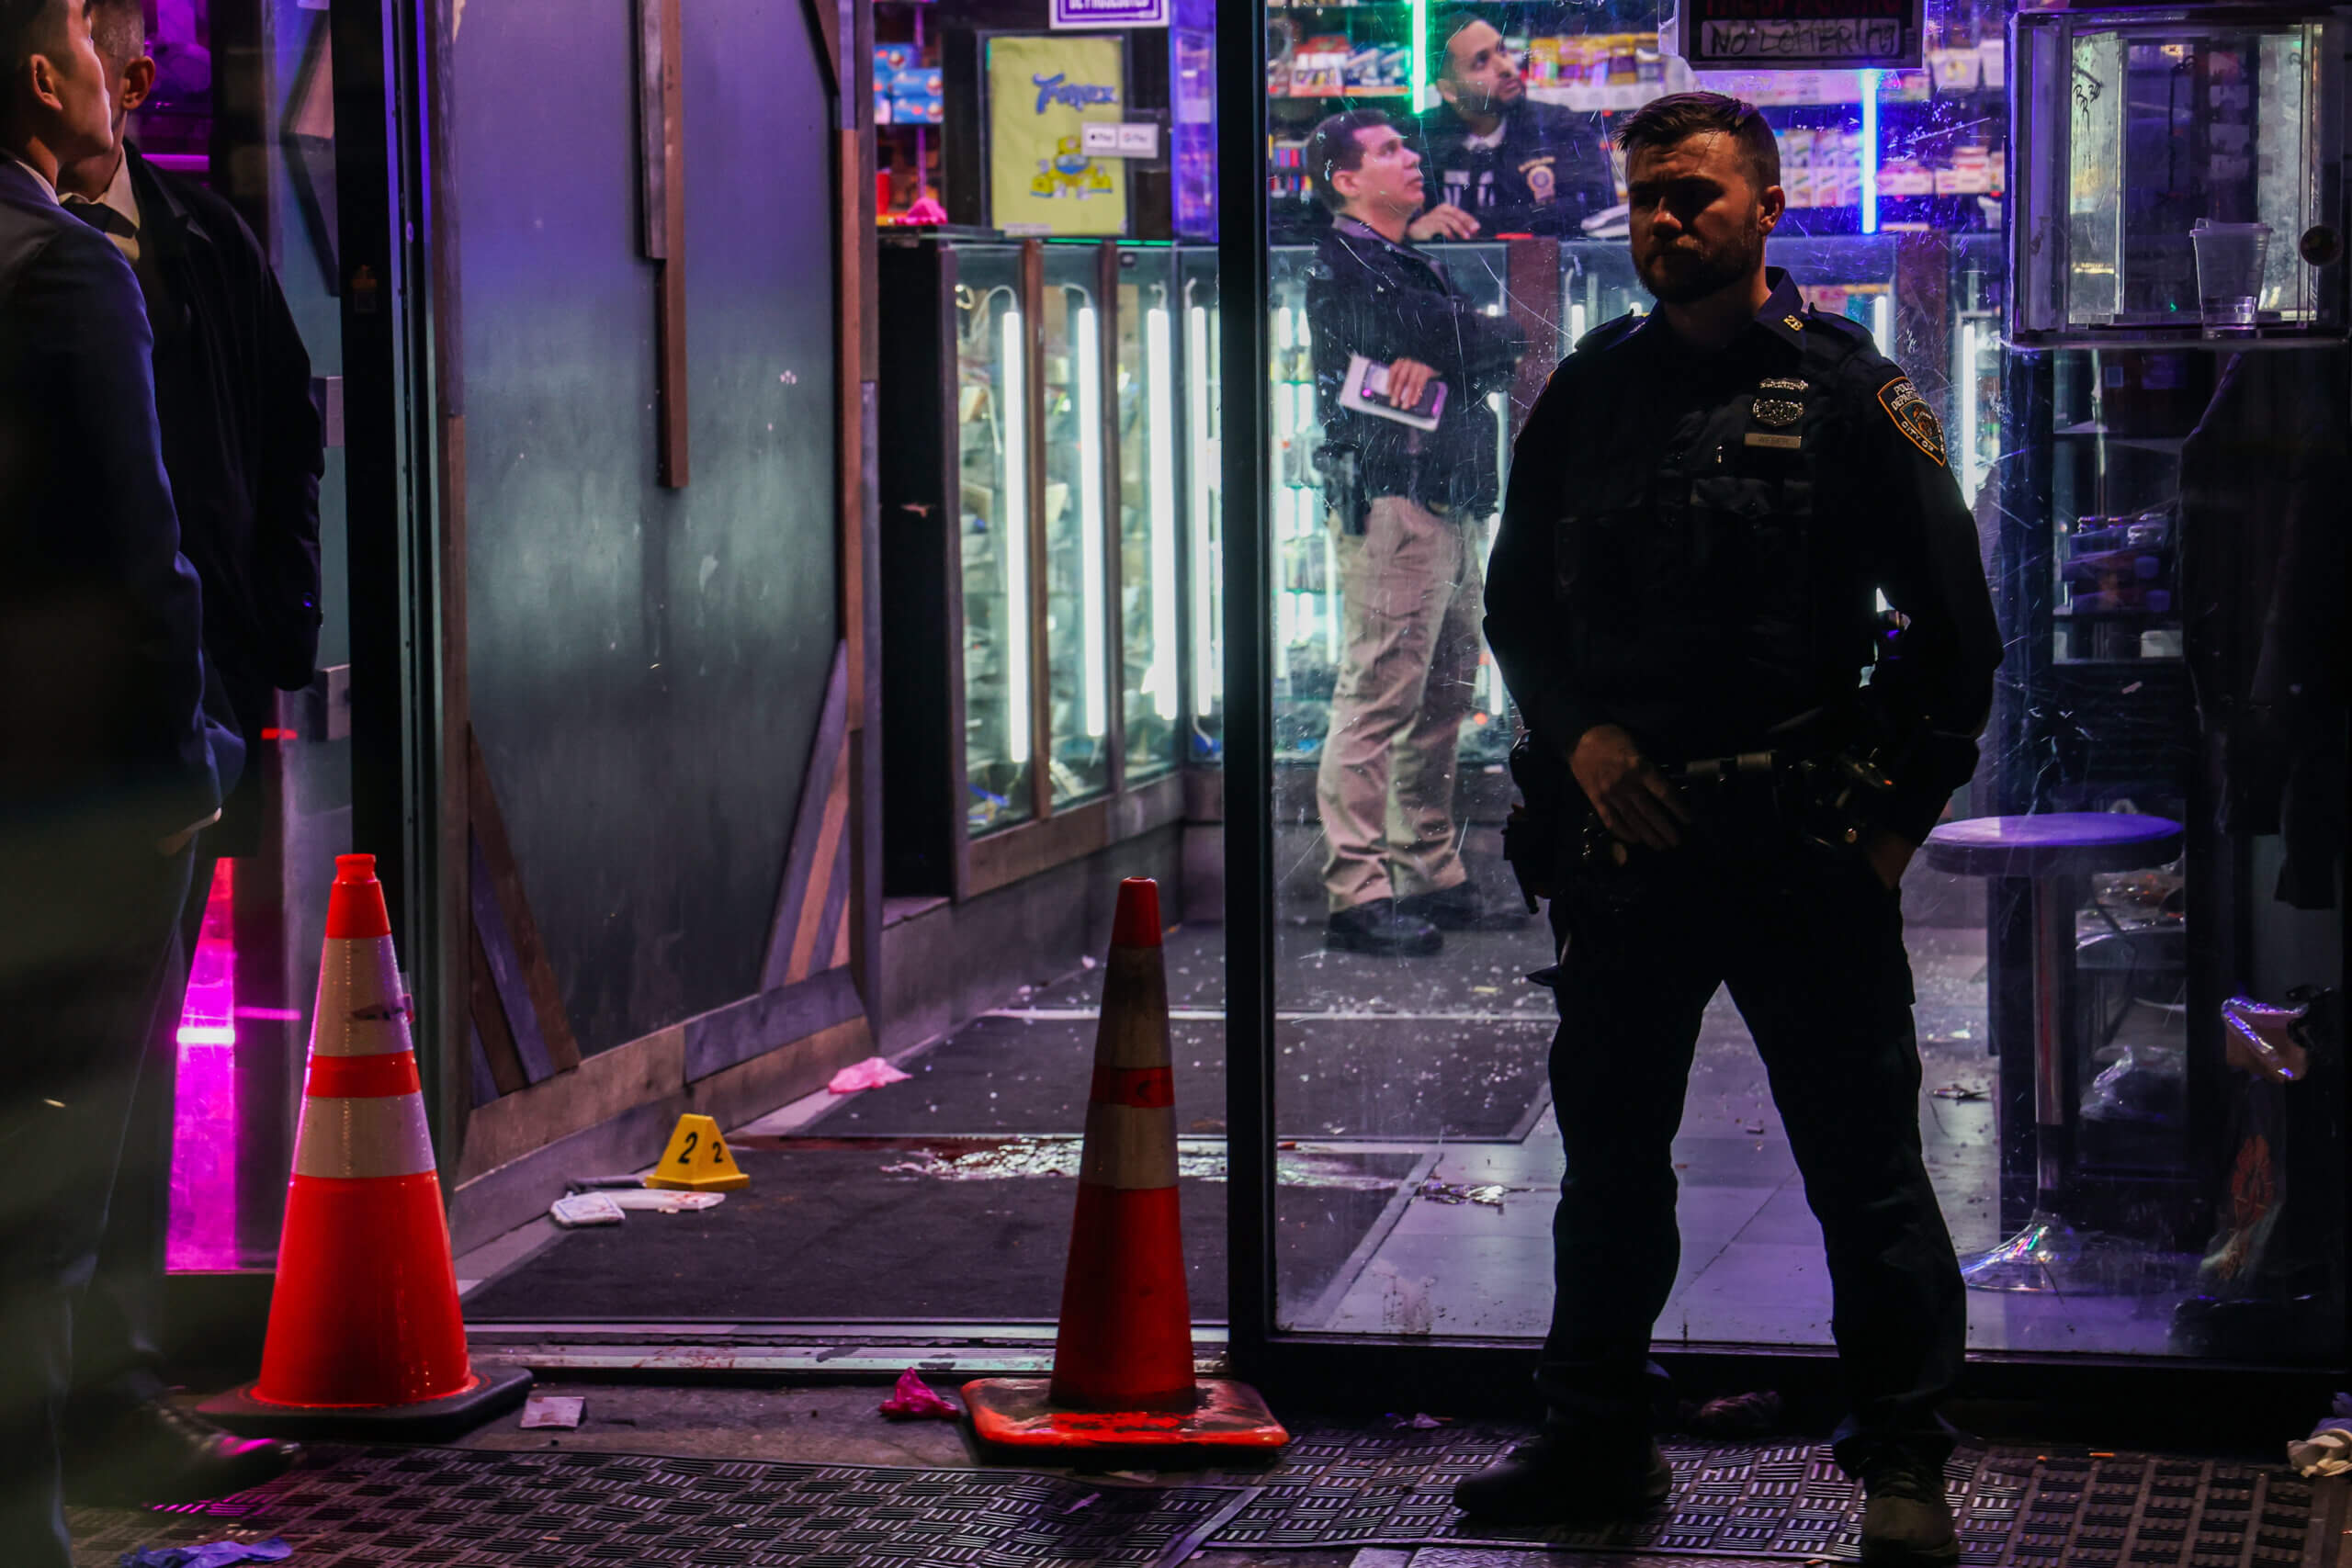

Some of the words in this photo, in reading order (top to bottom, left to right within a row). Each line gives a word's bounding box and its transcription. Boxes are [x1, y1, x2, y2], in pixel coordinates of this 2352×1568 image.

[1711, 25, 1747, 54] NO
[1901, 421, 1921, 441] CITY
[677, 1131, 698, 1164] 2
[712, 1141, 724, 1164] 2
